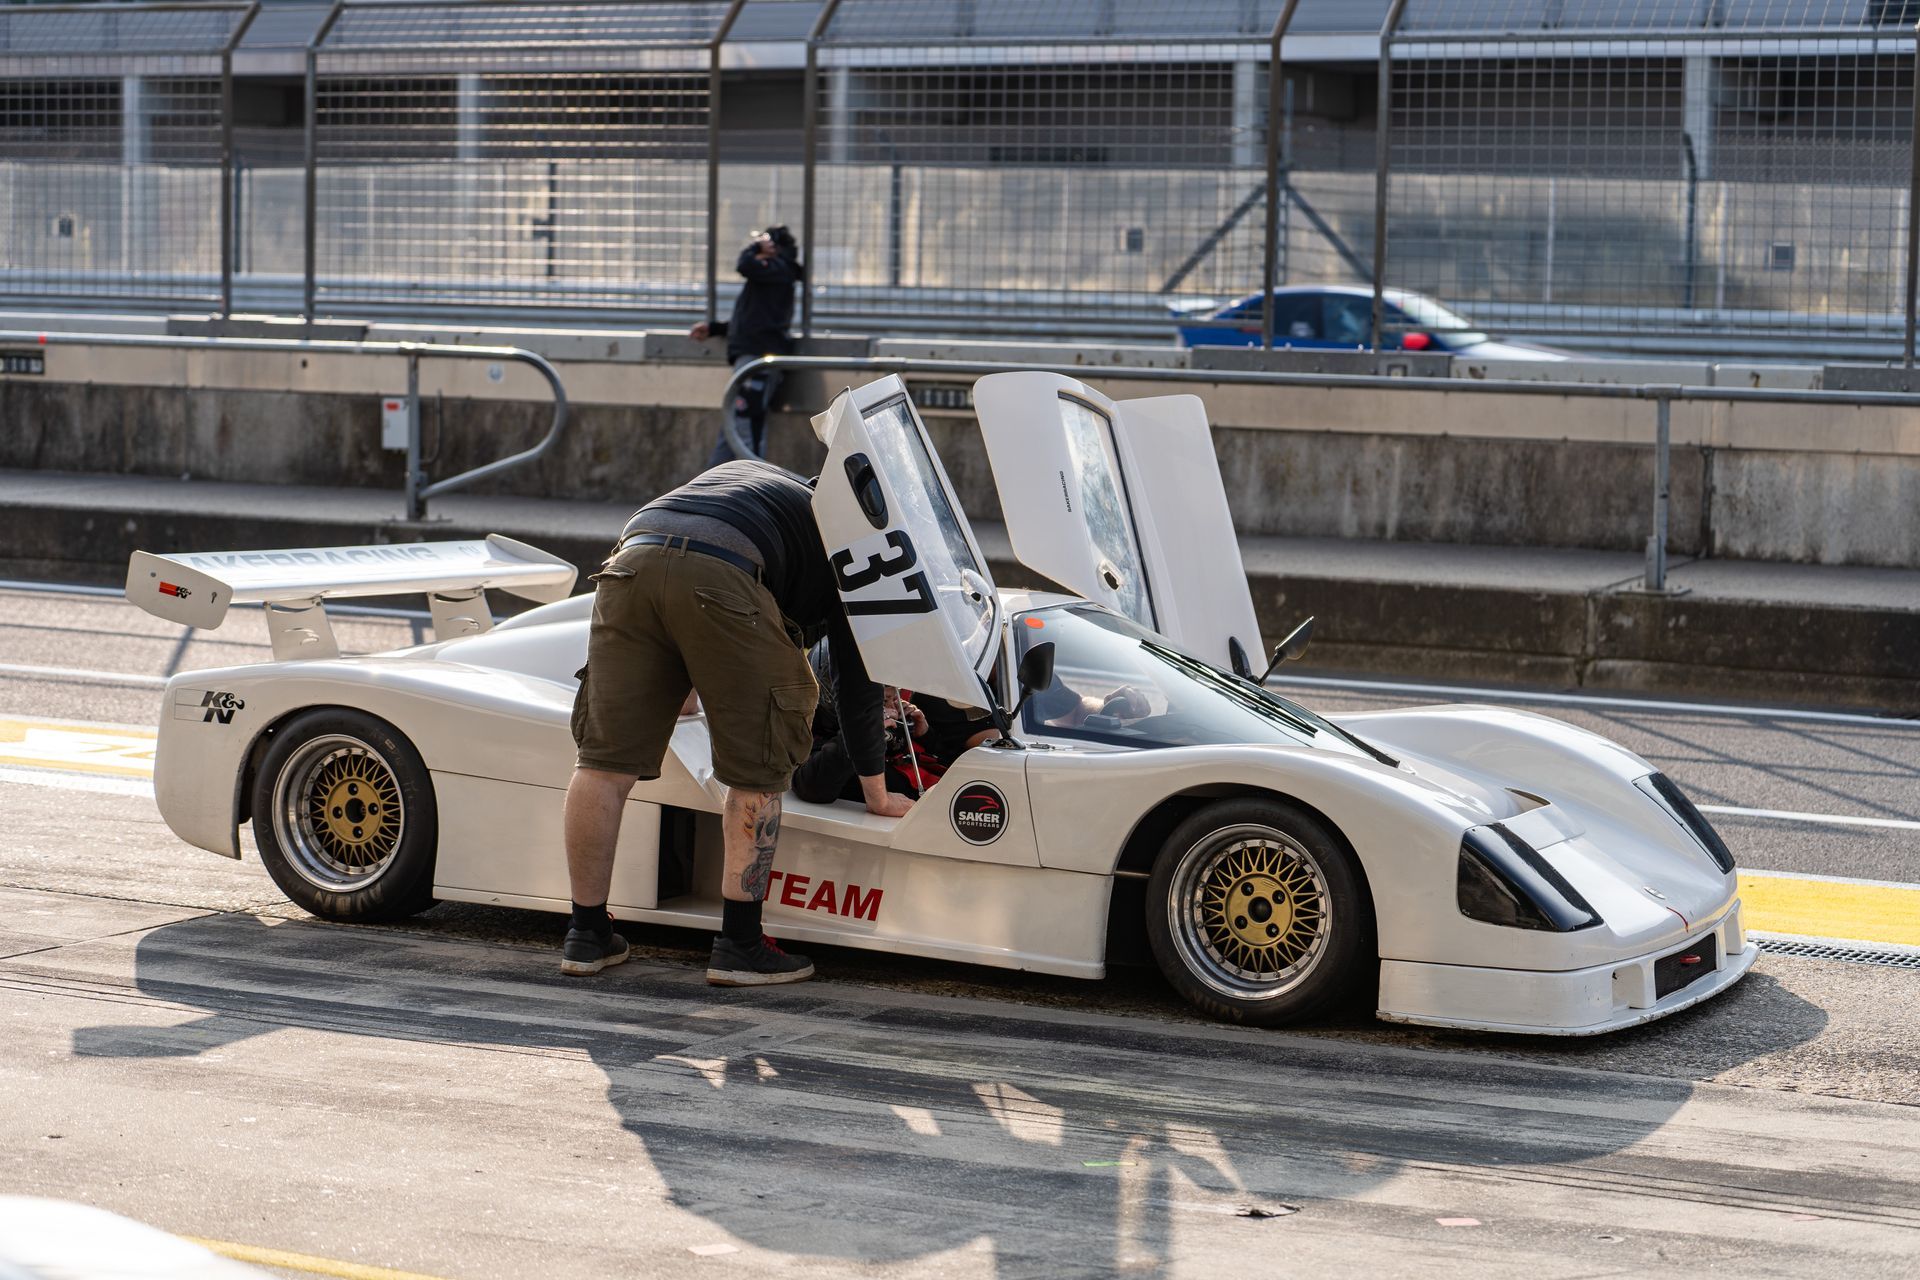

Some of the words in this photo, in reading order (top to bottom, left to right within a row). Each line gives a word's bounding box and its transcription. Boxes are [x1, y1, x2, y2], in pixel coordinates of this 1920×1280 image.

[169, 546, 441, 569] AKERRACING
[829, 529, 938, 616] 37
[958, 811, 1000, 823] SAKER
